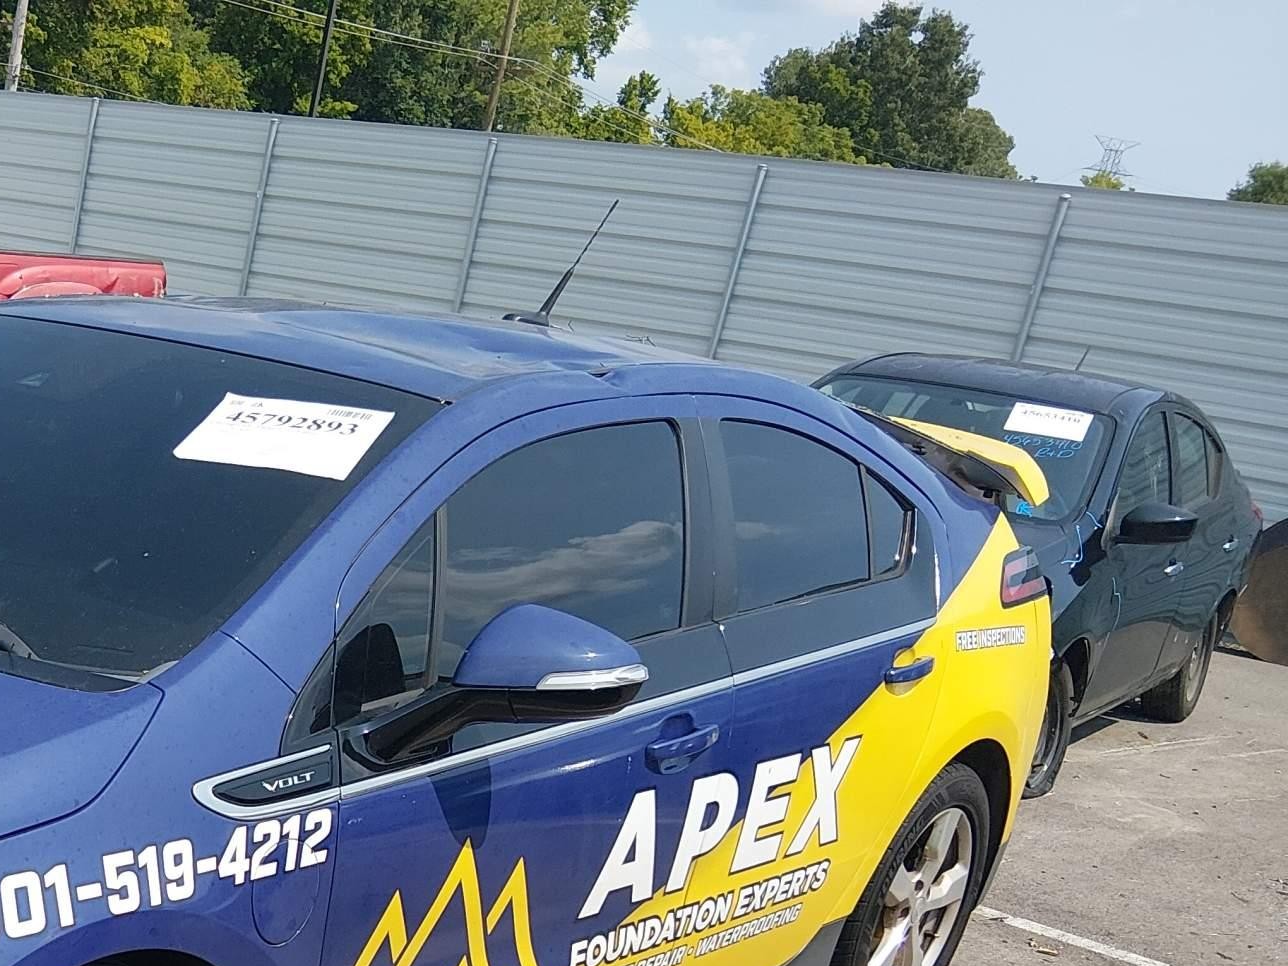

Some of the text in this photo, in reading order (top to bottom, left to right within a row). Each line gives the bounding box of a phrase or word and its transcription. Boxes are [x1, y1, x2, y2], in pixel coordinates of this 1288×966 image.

[226, 411, 359, 436] 45792893
[956, 626, 1025, 652] FREE INSPECTIONS
[261, 770, 316, 793] VOLT
[578, 734, 864, 920] APEX
[733, 859, 831, 921] EXPERTS
[695, 903, 803, 957] WATERPROOFING
